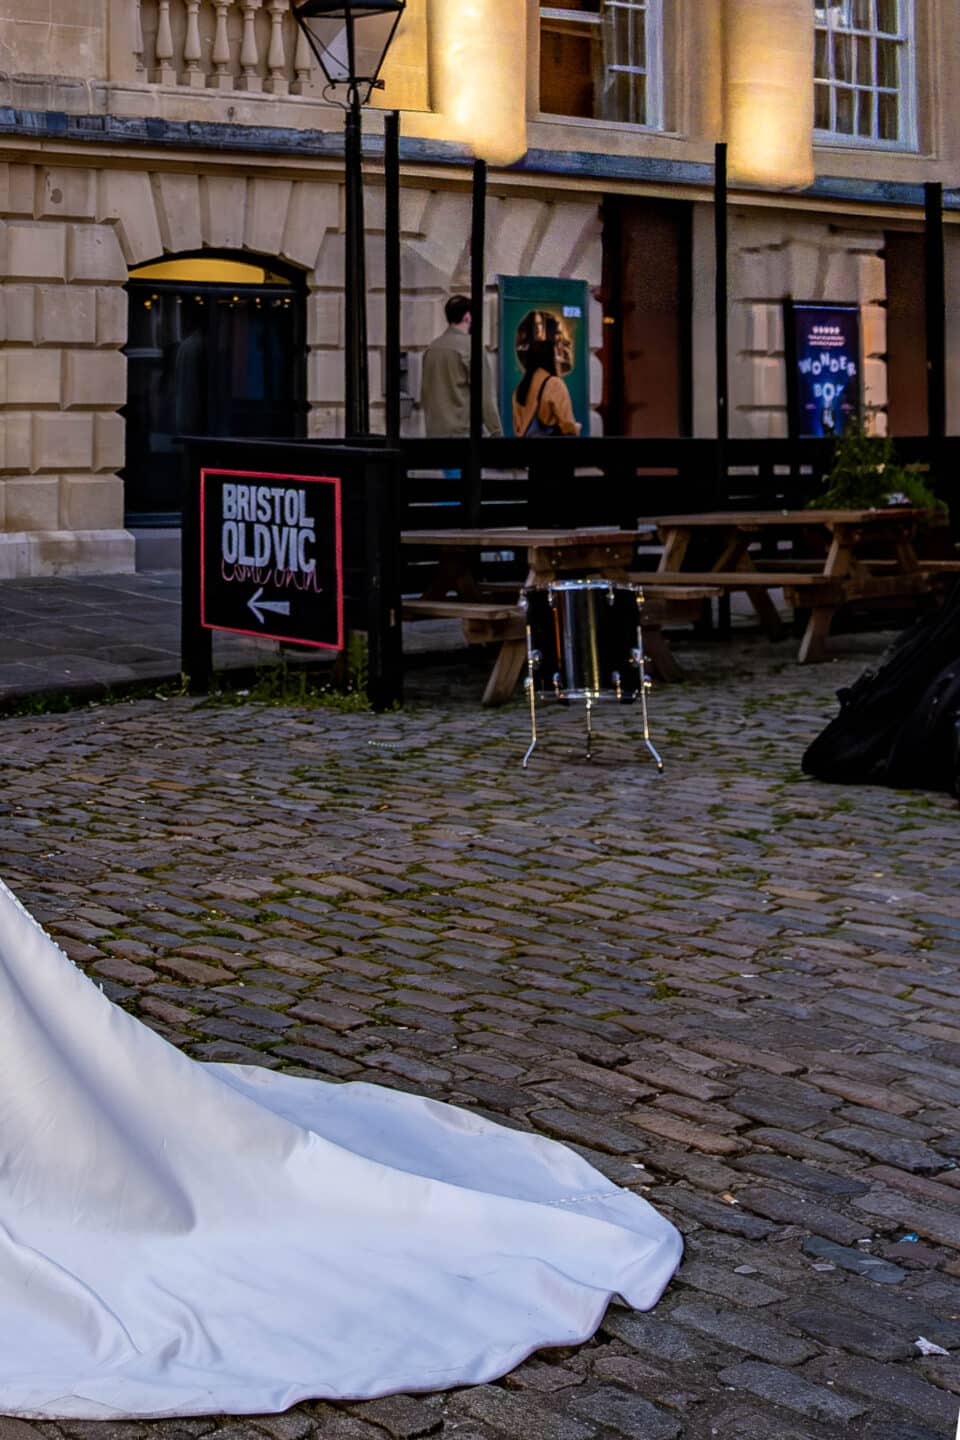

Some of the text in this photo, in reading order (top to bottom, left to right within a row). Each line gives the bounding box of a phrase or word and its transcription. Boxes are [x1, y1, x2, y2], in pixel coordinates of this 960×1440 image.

[798, 351, 857, 377] WONDER
[813, 382, 845, 402] BOY
[222, 482, 315, 528] BRISTOL
[221, 520, 317, 573] OLD VIC
